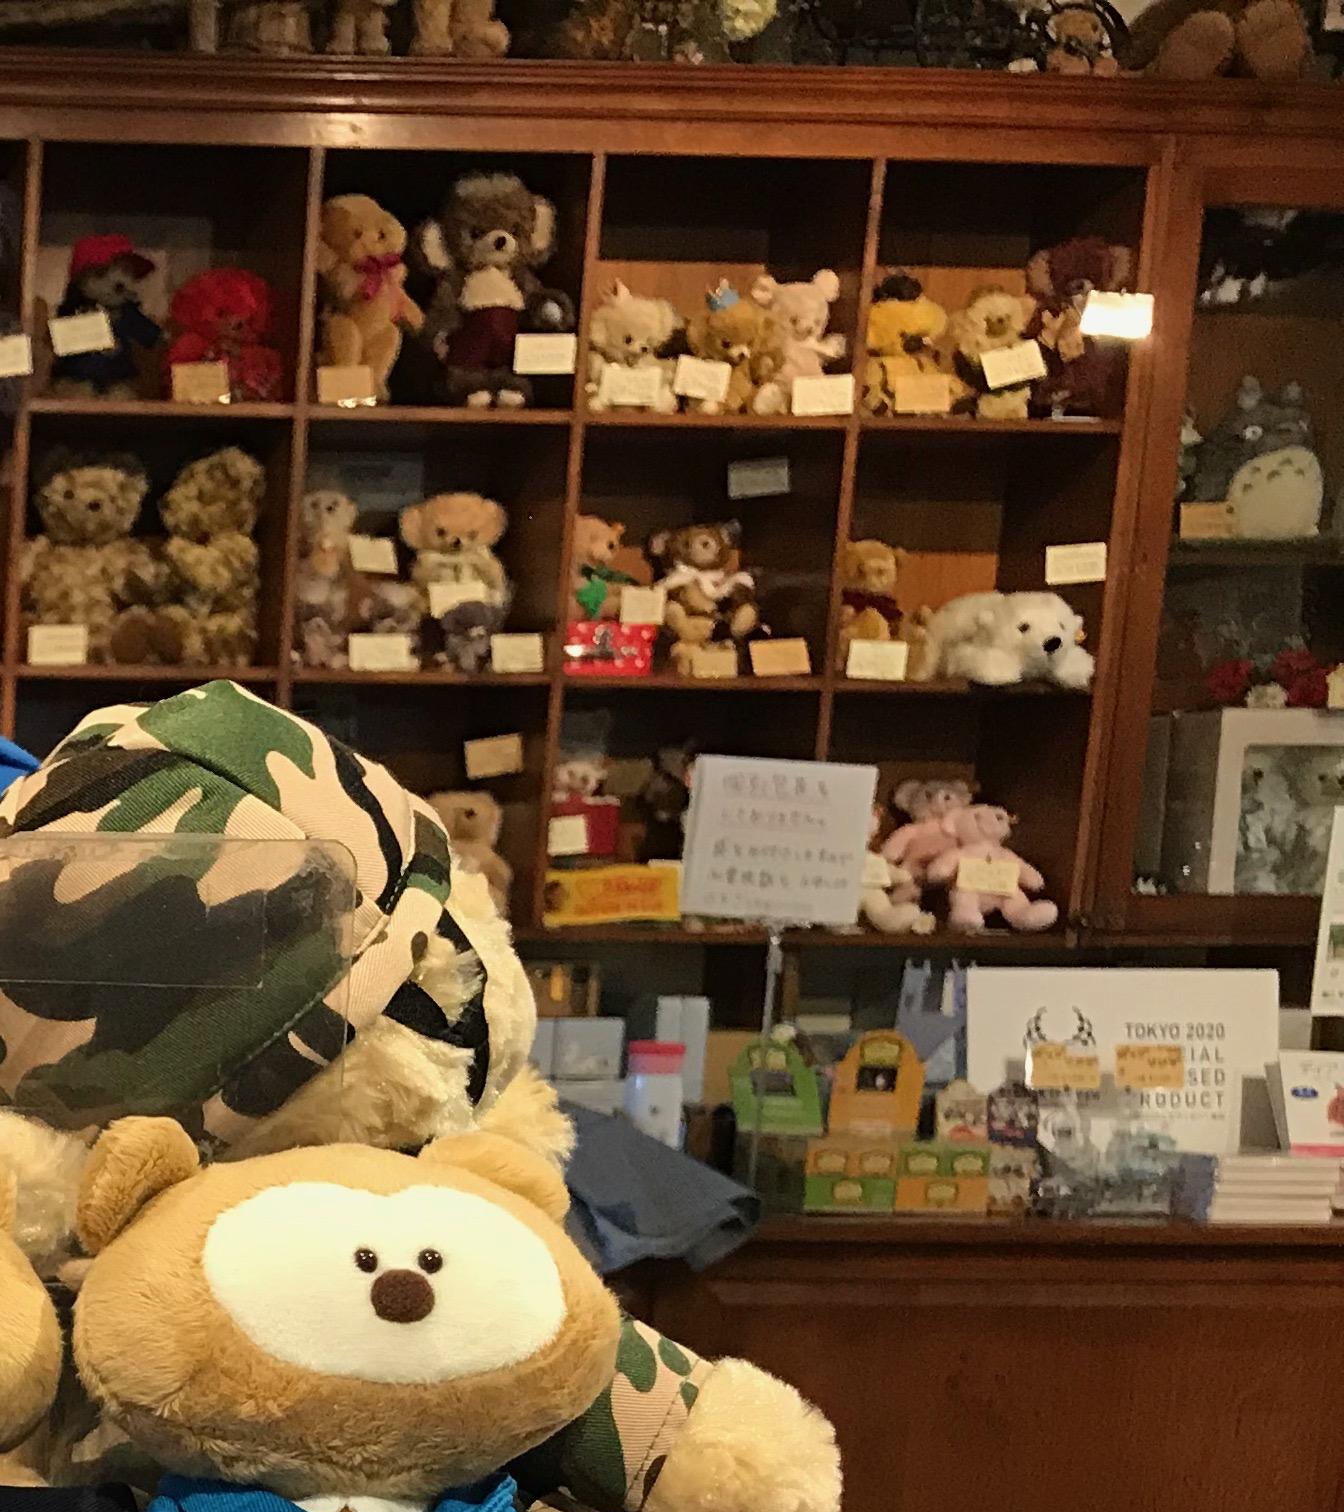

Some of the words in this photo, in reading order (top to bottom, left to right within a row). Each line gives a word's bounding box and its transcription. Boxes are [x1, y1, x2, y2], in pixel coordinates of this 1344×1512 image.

[1125, 1021, 1180, 1040] TOKYO
[1186, 1021, 1225, 1040] 2020
[1138, 1089, 1225, 1108] RODUCT
